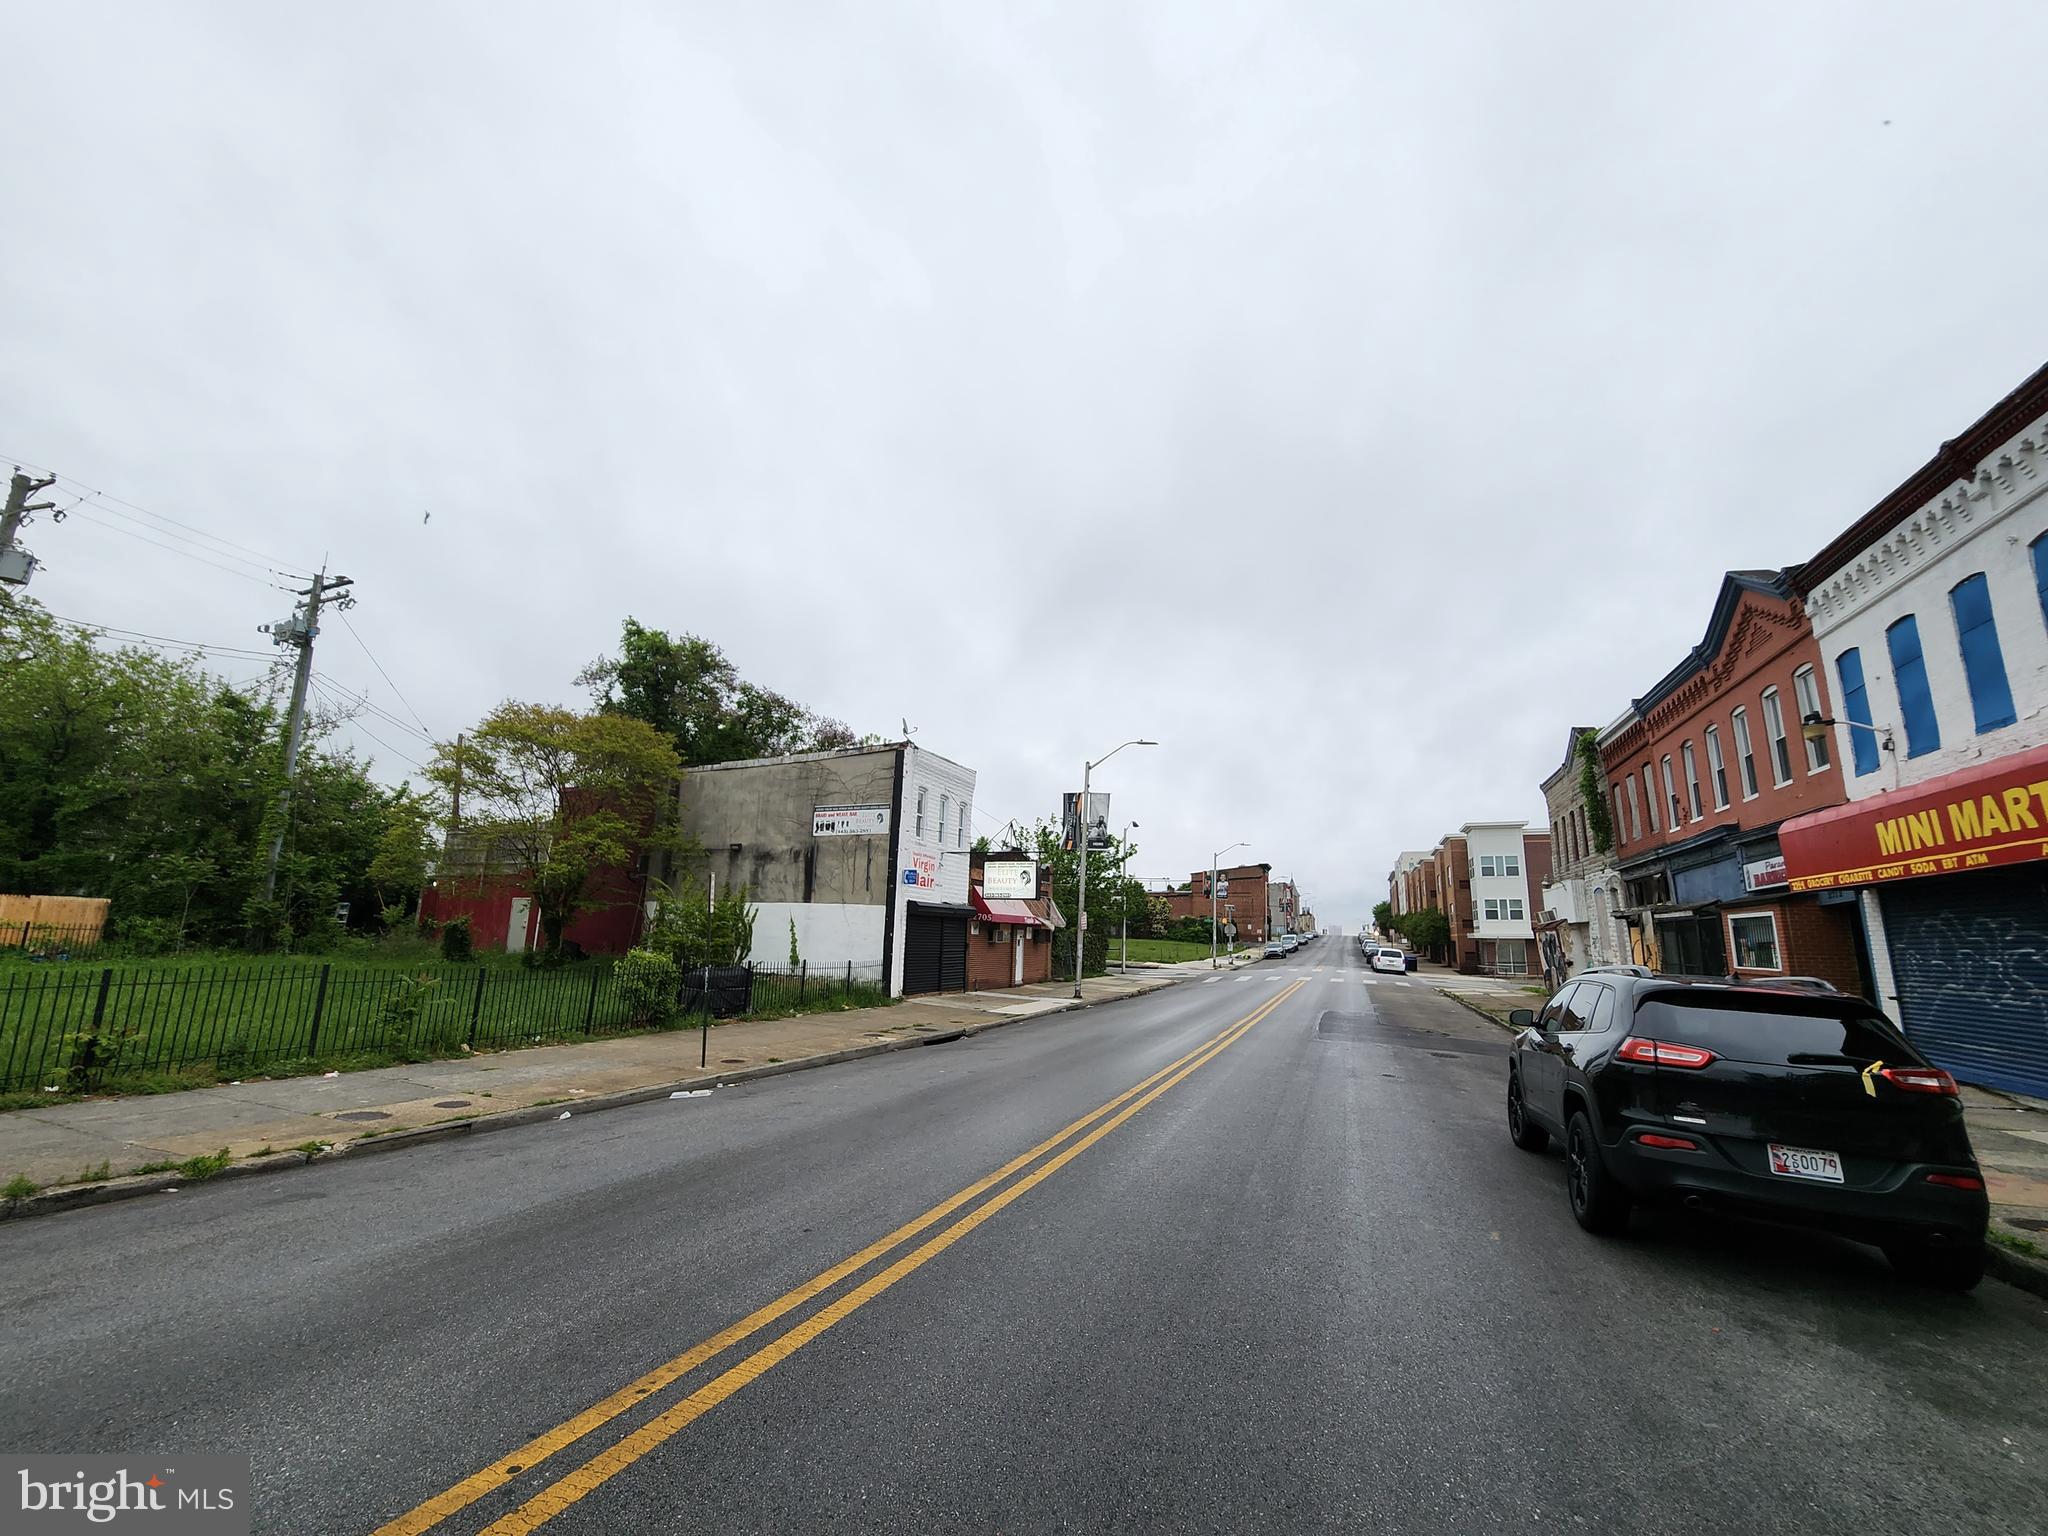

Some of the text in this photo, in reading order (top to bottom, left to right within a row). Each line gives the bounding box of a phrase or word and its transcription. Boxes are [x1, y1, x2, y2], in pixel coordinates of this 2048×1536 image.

[1875, 809, 1945, 856] MINI
[912, 857, 935, 873] Virgin
[1807, 876, 1834, 889] GROCERY
[1838, 870, 1873, 884] CIGARETTE
[1877, 866, 1906, 879] CANDY
[1911, 861, 1937, 875] SODA
[1942, 857, 1958, 870] EBT
[1965, 853, 1989, 867] ATM
